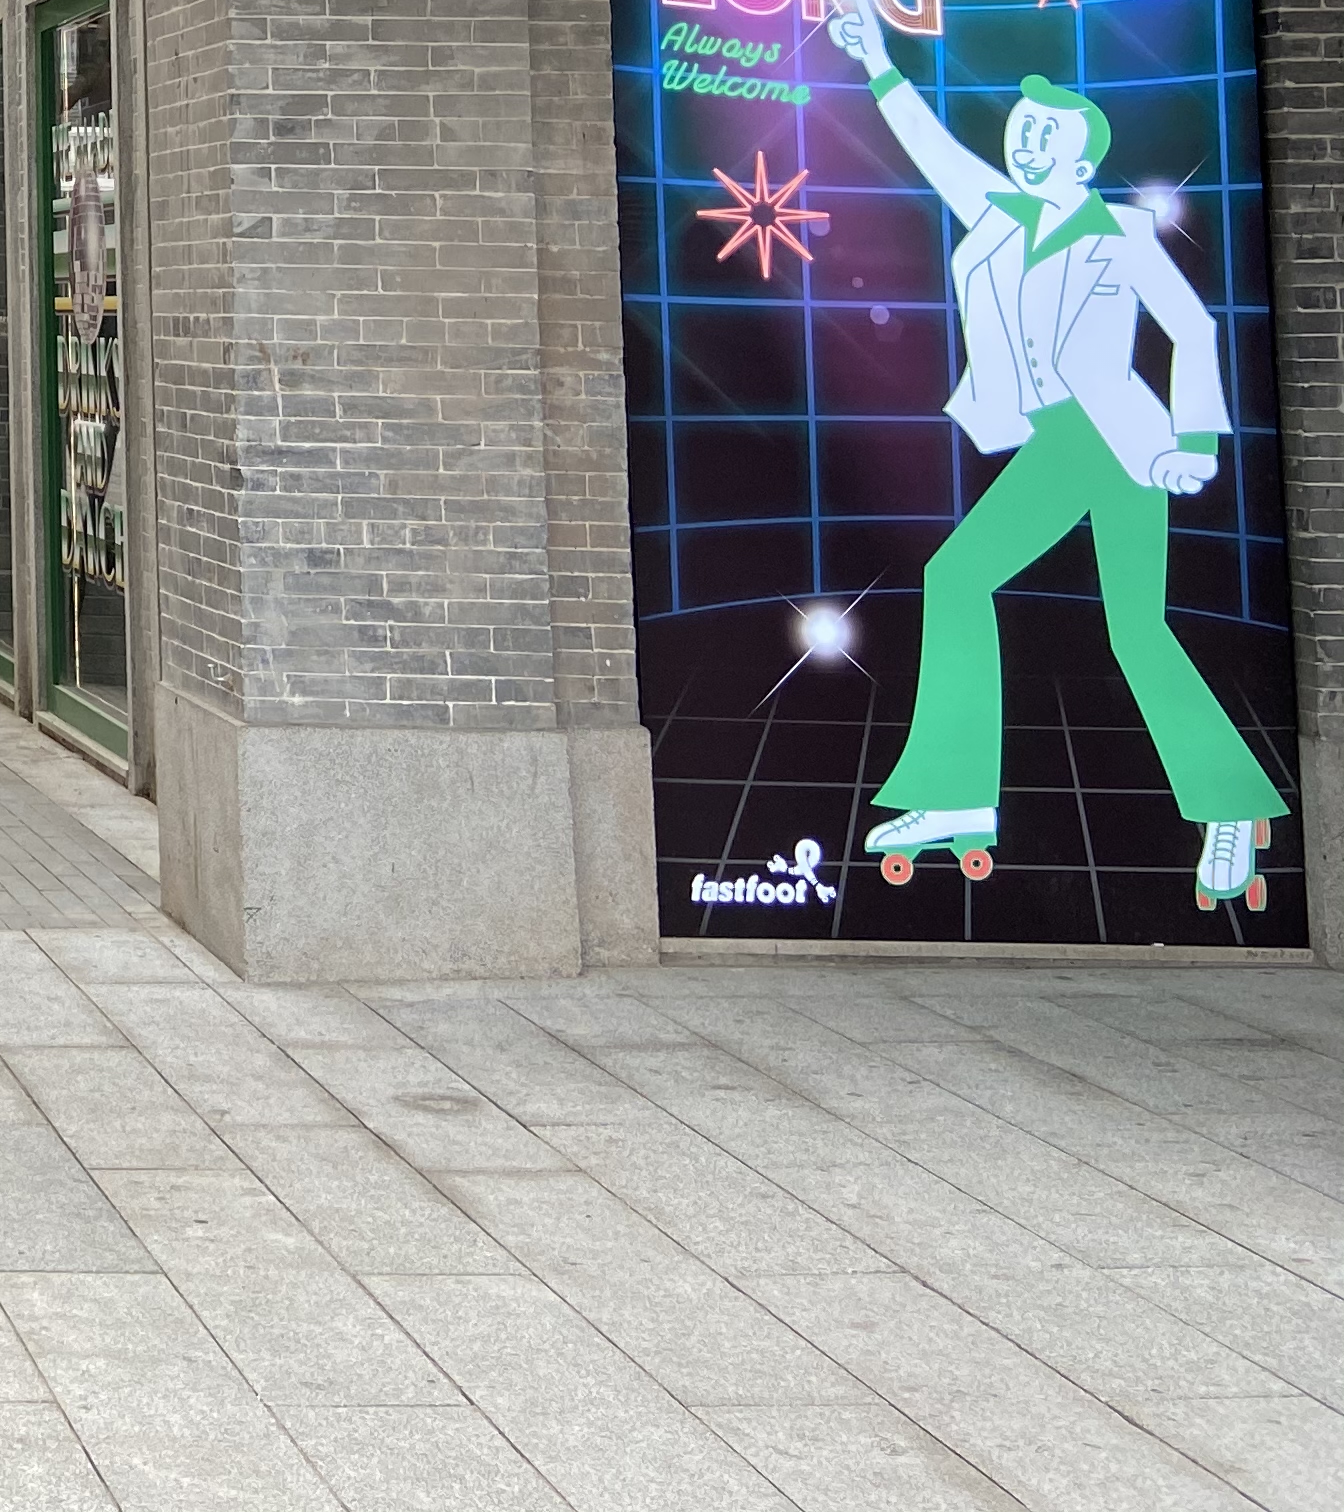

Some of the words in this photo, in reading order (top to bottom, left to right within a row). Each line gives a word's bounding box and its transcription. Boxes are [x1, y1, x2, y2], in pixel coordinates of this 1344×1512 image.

[662, 21, 782, 70] Always
[661, 58, 812, 107] Welcome
[690, 873, 808, 905] fastfoot
